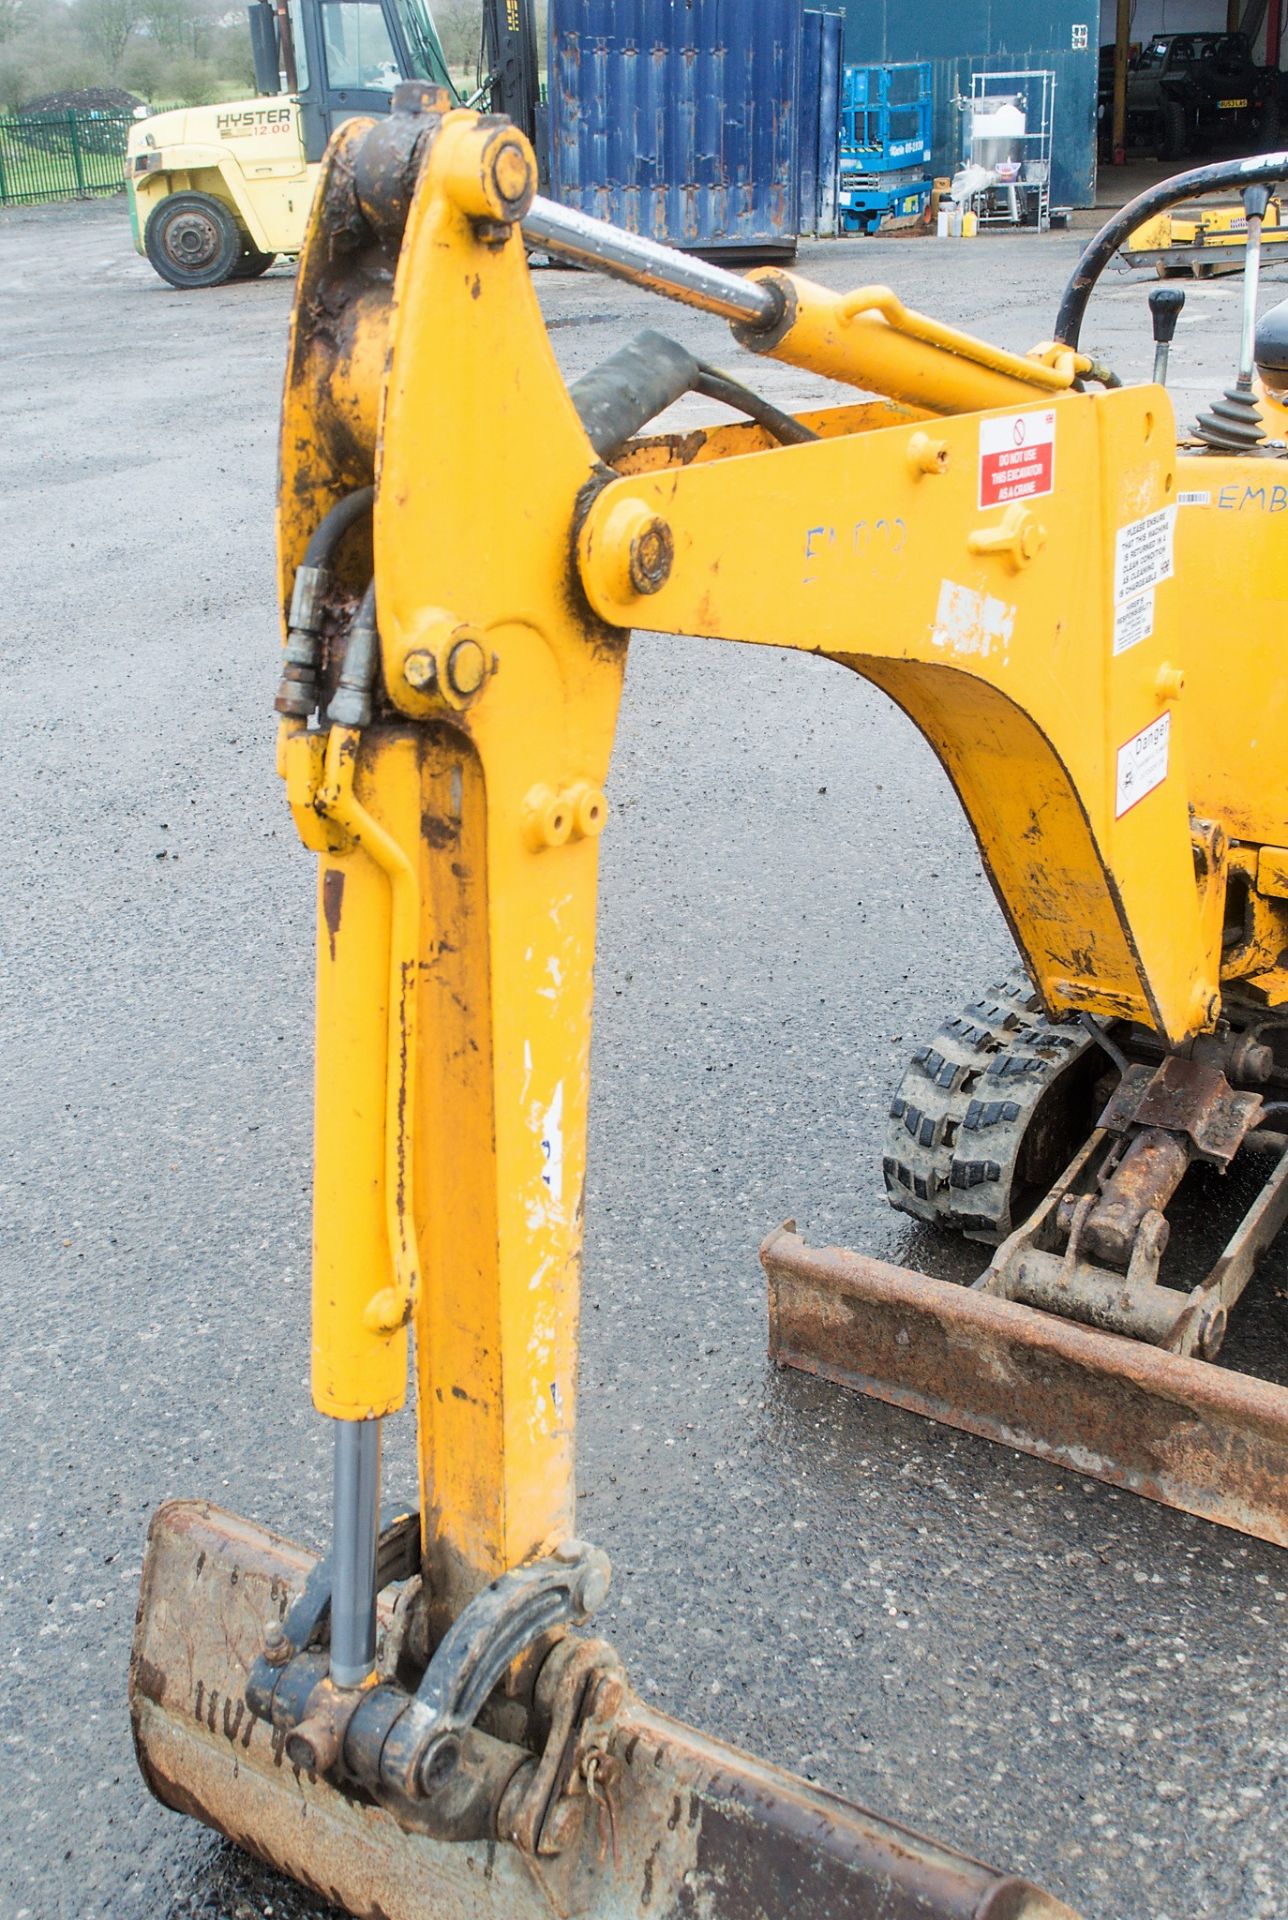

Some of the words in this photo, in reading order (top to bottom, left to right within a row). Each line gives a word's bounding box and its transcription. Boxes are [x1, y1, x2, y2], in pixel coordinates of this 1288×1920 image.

[217, 109, 291, 129] HYSTER
[254, 124, 291, 136] 12.00
[998, 454, 1009, 467] DO
[1009, 451, 1023, 464] NOT
[1023, 448, 1038, 462] USE
[992, 470, 1007, 485] THIS
[1007, 463, 1043, 482] EXCAVATOR
[998, 487, 1009, 501] AS
[1014, 481, 1037, 497] CRANE
[1126, 522, 1146, 537] PLEASE
[1146, 512, 1166, 528] ENSURE
[1122, 538, 1135, 549] THAT
[1135, 532, 1147, 543] THIS
[1147, 522, 1169, 538] MACHINE
[1130, 539, 1156, 557] RETURNED
[1122, 560, 1139, 574] CLEAN
[1140, 546, 1166, 565] CONDITION
[1130, 561, 1154, 580] CLEANING
[1125, 571, 1157, 595] CHARGEABLE
[1136, 719, 1169, 755] Danger
